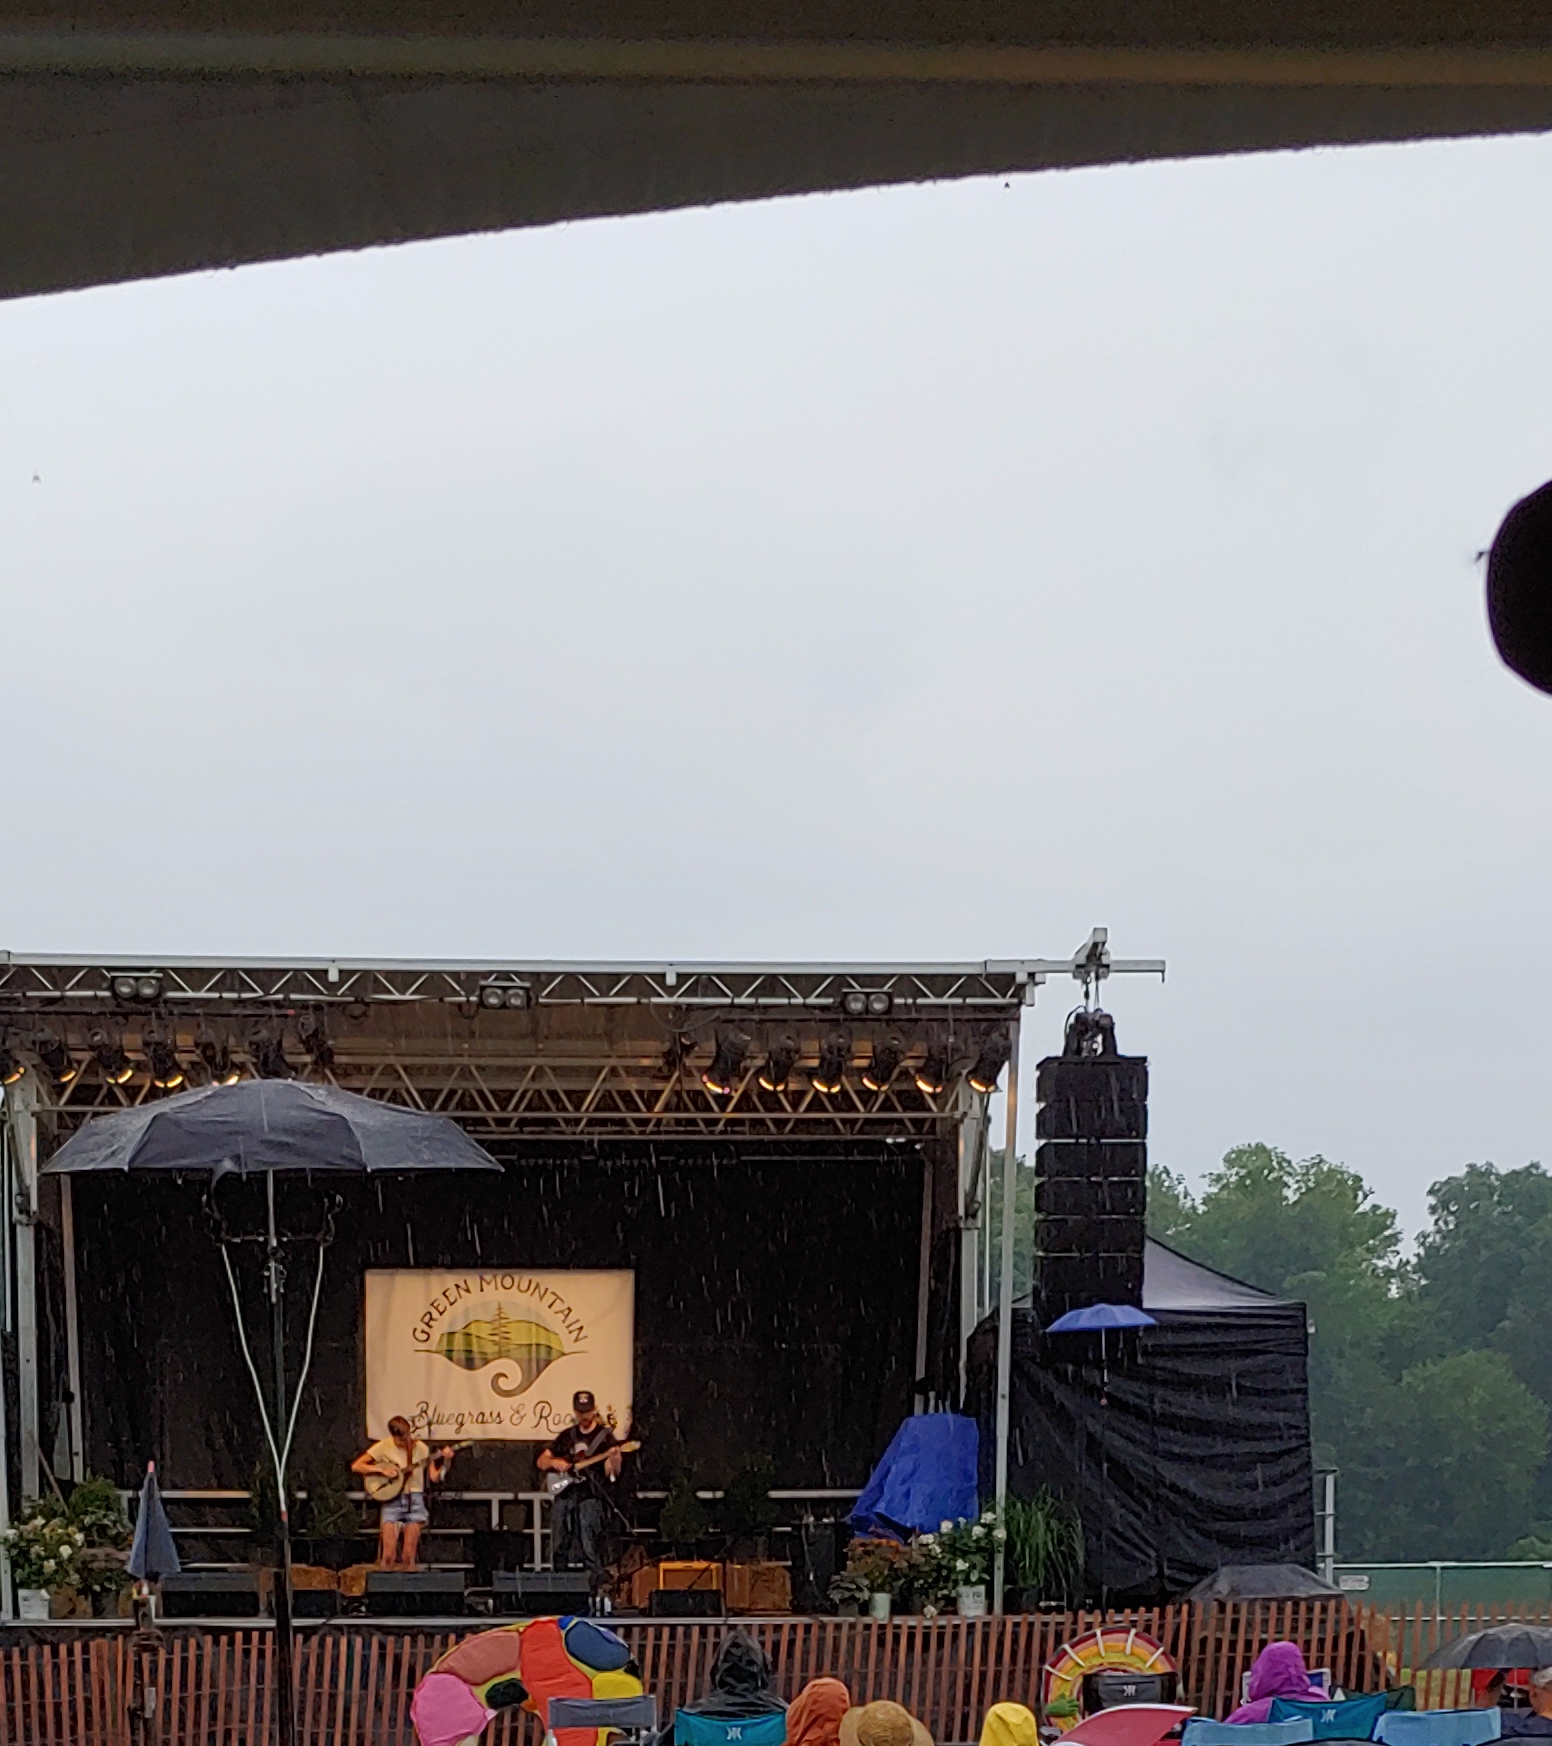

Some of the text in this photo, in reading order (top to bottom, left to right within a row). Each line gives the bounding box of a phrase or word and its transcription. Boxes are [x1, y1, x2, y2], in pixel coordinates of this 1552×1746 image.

[412, 1273, 588, 1344] GREEN MOUNTAIN
[411, 1401, 504, 1435] Bluegrass
[509, 1403, 528, 1427] &
